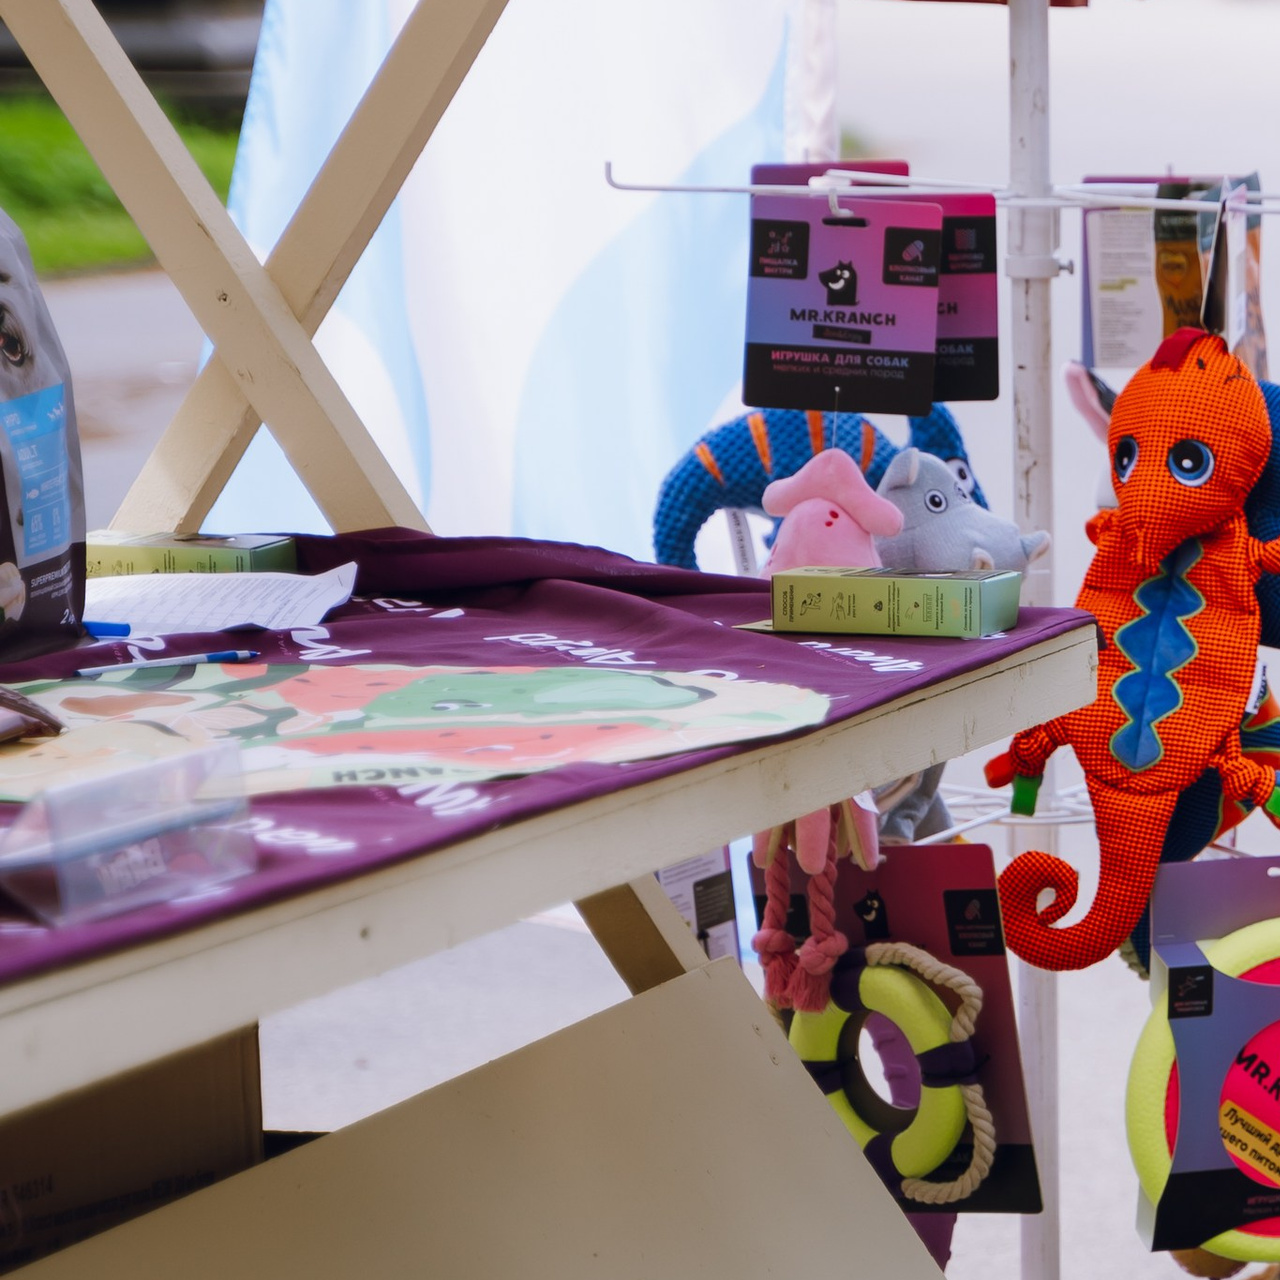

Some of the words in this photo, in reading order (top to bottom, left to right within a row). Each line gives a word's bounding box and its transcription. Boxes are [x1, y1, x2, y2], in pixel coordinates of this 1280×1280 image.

[759, 256, 798, 266] ПИЩАЛКА
[764, 267, 793, 276] ВНУТРИ
[790, 308, 896, 326] MR.KRANCH
[771, 350, 830, 363] ИГРУШКА
[834, 353, 861, 366] ДЛЯ
[866, 355, 910, 368] СОБАК
[870, 369, 905, 380] пород
[1224, 1107, 1273, 1145] Лучший
[1220, 1126, 1249, 1151] шего
